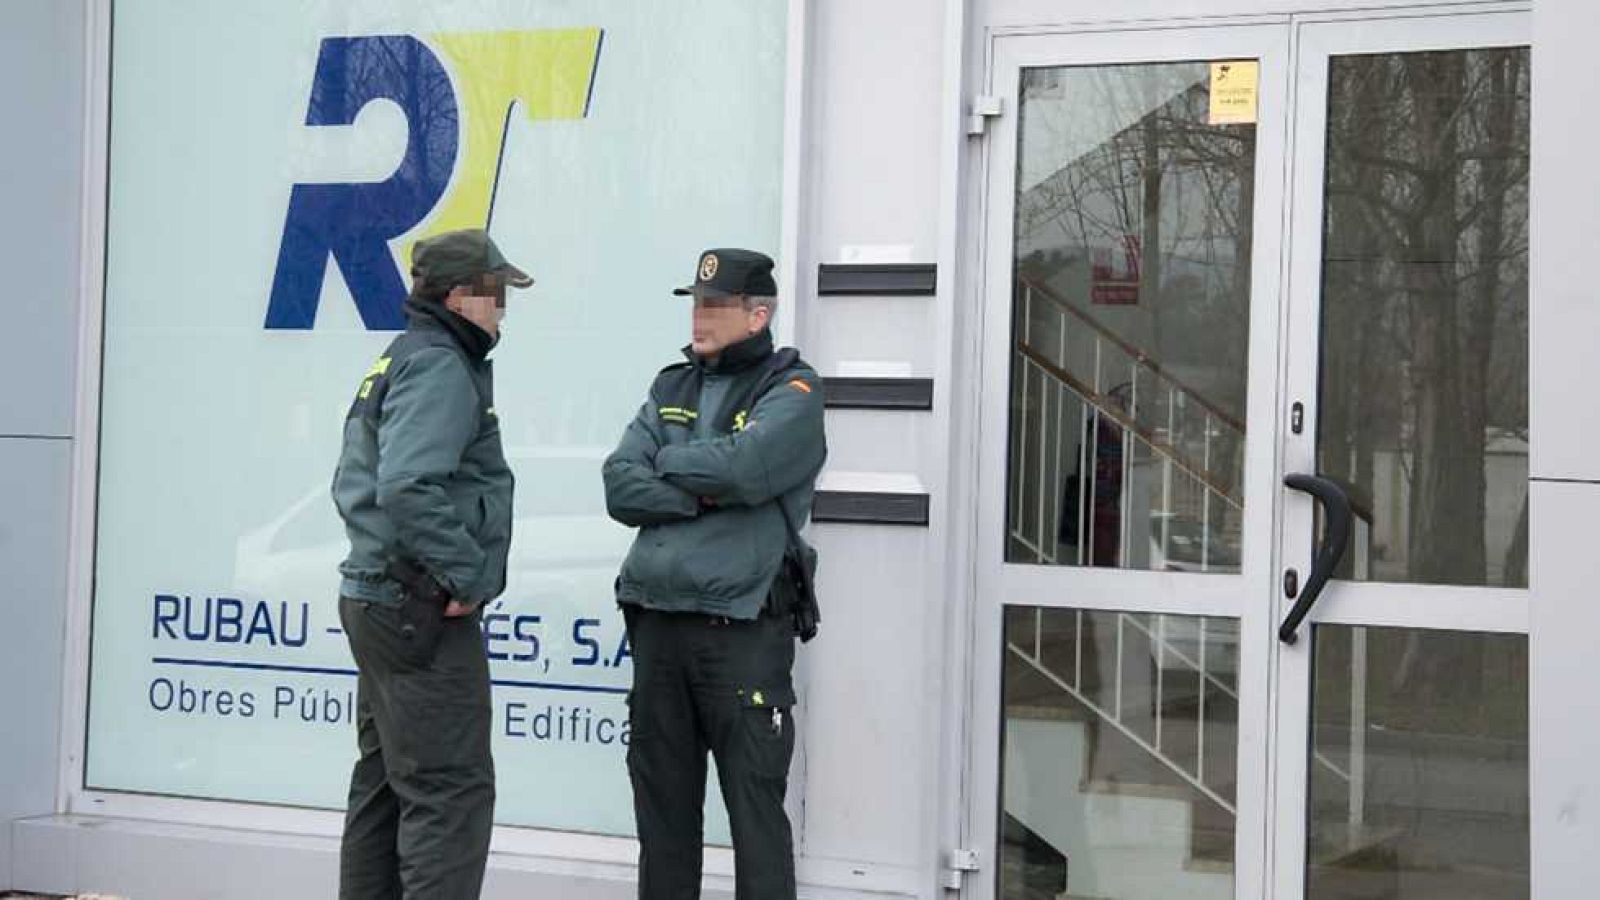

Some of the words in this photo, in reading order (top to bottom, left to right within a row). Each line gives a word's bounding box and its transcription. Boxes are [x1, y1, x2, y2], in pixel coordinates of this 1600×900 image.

[153, 595, 309, 647] RUBAU
[150, 677, 255, 718] Obres
[274, 686, 352, 725] Públ
